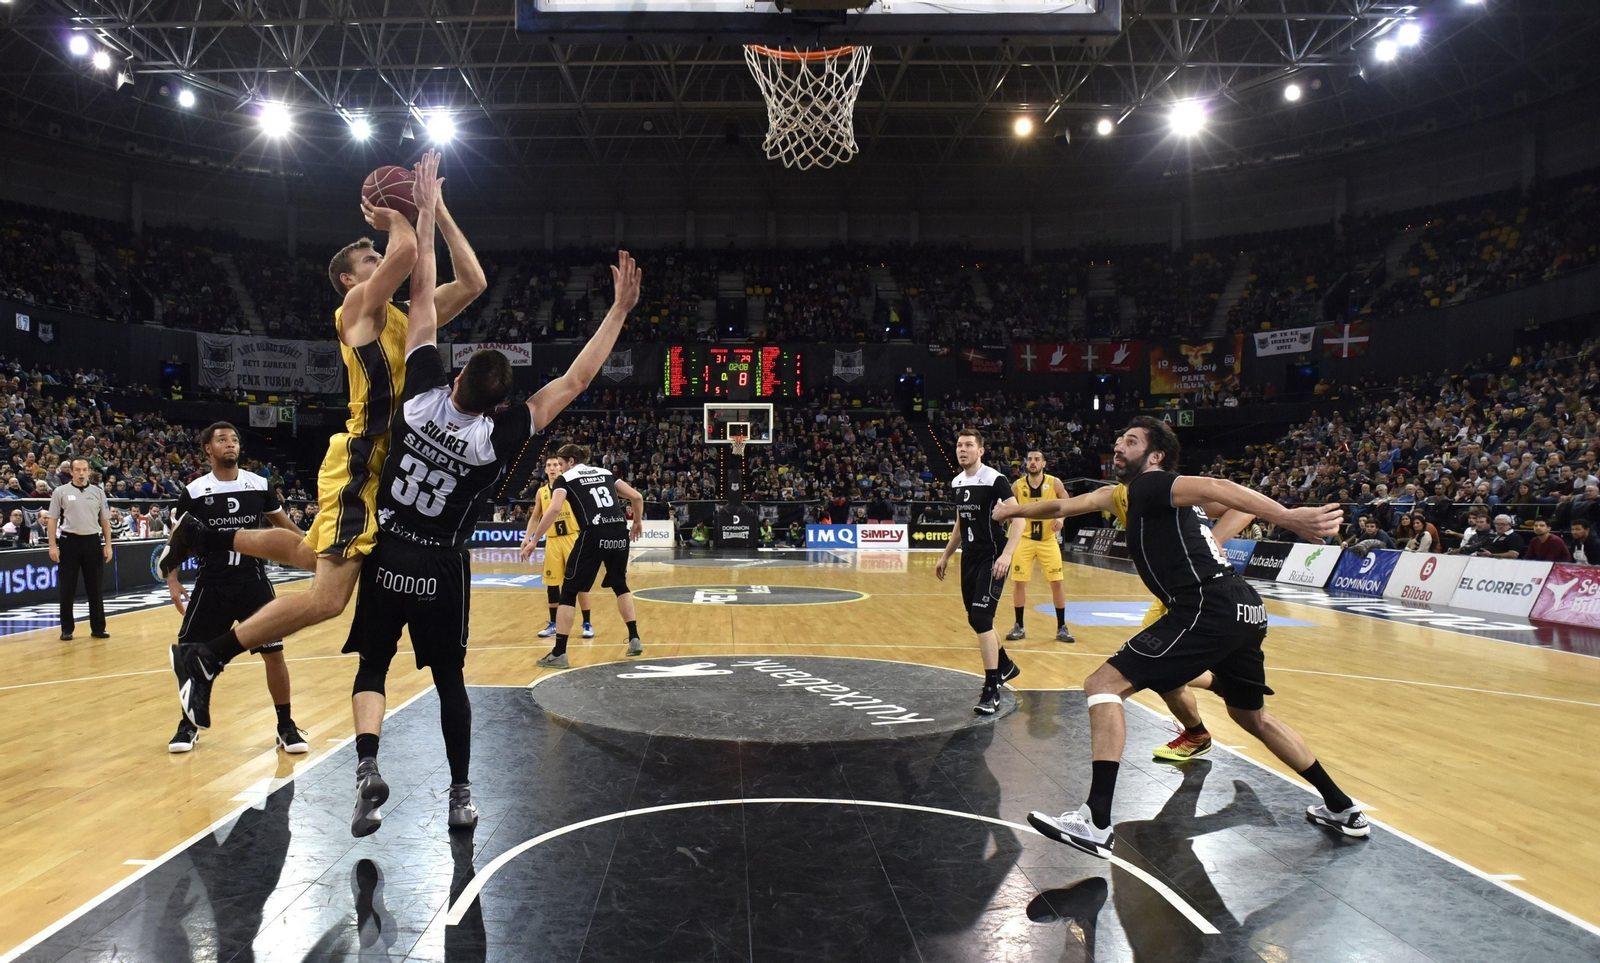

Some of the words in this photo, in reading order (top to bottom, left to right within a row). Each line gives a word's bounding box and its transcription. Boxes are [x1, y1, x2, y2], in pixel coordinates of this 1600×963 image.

[256, 342, 277, 352] BILBAO
[279, 344, 304, 360] BASKET
[454, 346, 473, 360] PEÑA
[242, 359, 260, 368] BETI
[262, 360, 297, 369] ZUREKIN
[716, 354, 726, 364] 31
[740, 354, 751, 363] 29
[728, 363, 749, 371] 02:08
[263, 375, 291, 387] TURIN
[738, 372, 748, 386] 8
[1162, 413, 1173, 423] A
[420, 420, 469, 459] SUÁREZ
[390, 453, 458, 518] 33
[589, 486, 614, 508] 13
[208, 514, 257, 526] DOMINION
[558, 523, 563, 534] 5
[641, 529, 670, 539] ndesa
[1033, 523, 1040, 534] 14
[1095, 529, 1117, 538] HOTEL
[807, 528, 856, 544] IMQ
[599, 538, 627, 550] FOODOO
[1248, 553, 1287, 569] kutxaban
[375, 567, 437, 596] FOODOO
[1287, 569, 1314, 584] Bizkaia
[1334, 576, 1381, 593] DOMINION
[1458, 577, 1474, 590] EL
[1475, 579, 1534, 597] CORREO
[1400, 585, 1433, 602] Bilbao
